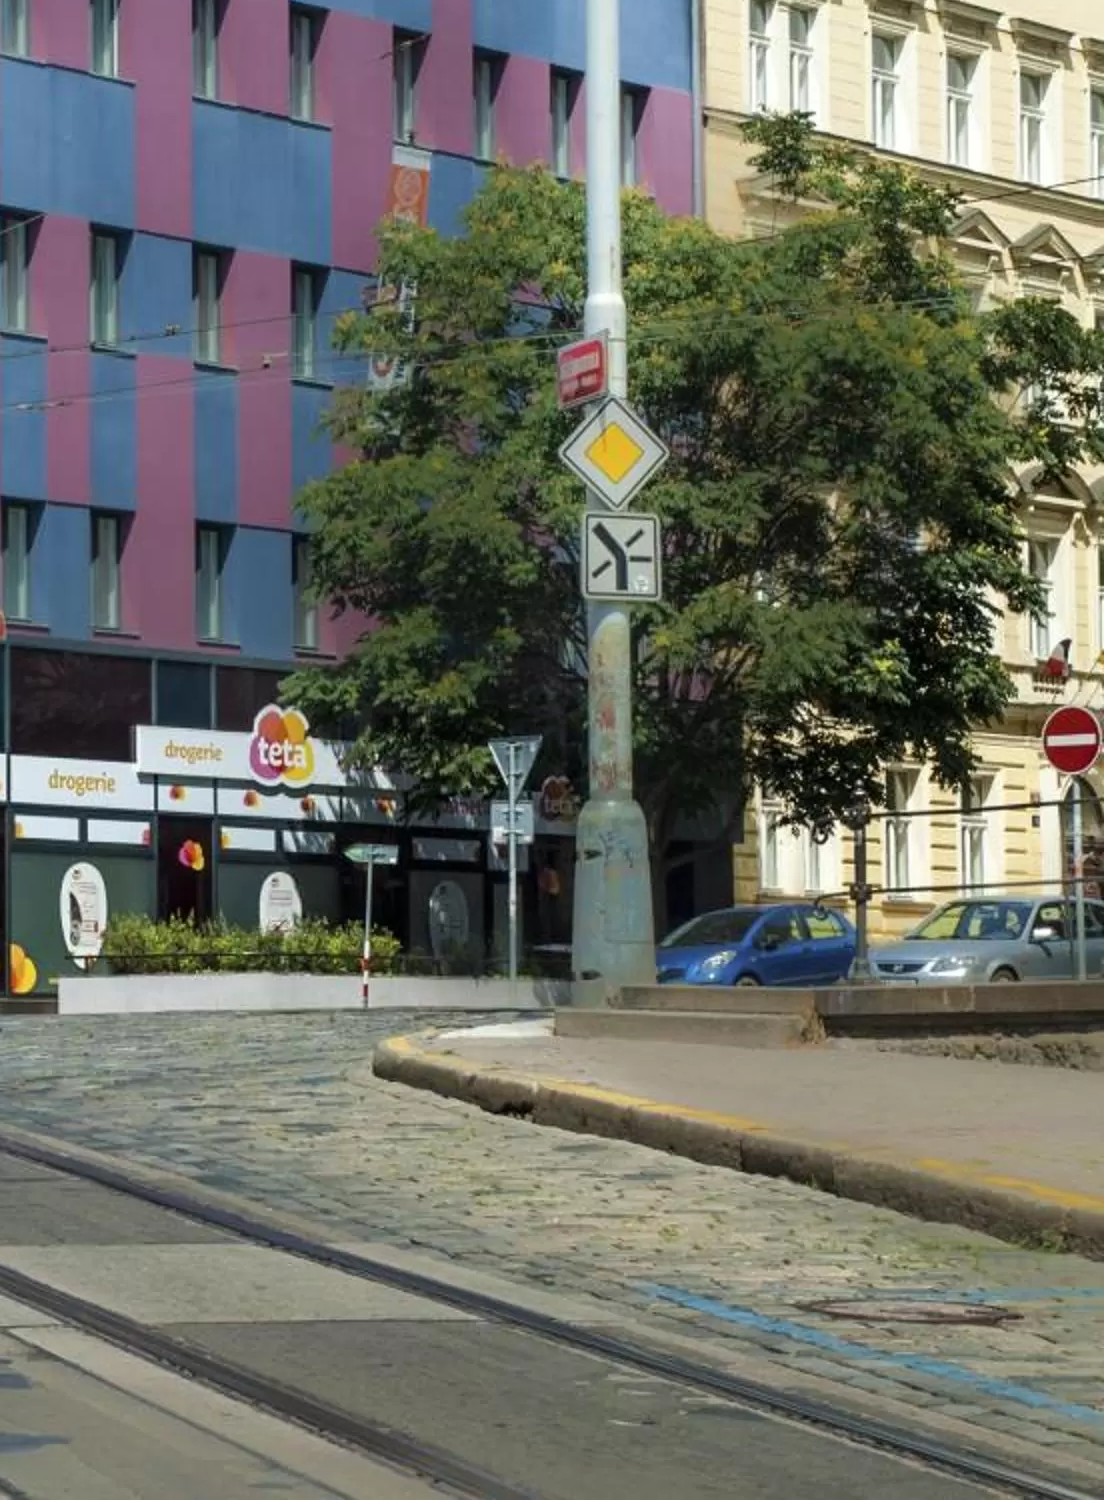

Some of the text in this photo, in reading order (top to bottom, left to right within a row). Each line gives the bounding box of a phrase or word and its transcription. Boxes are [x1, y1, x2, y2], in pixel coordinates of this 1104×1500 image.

[165, 737, 307, 768] drogerie teta
[48, 769, 116, 796] drogerie
